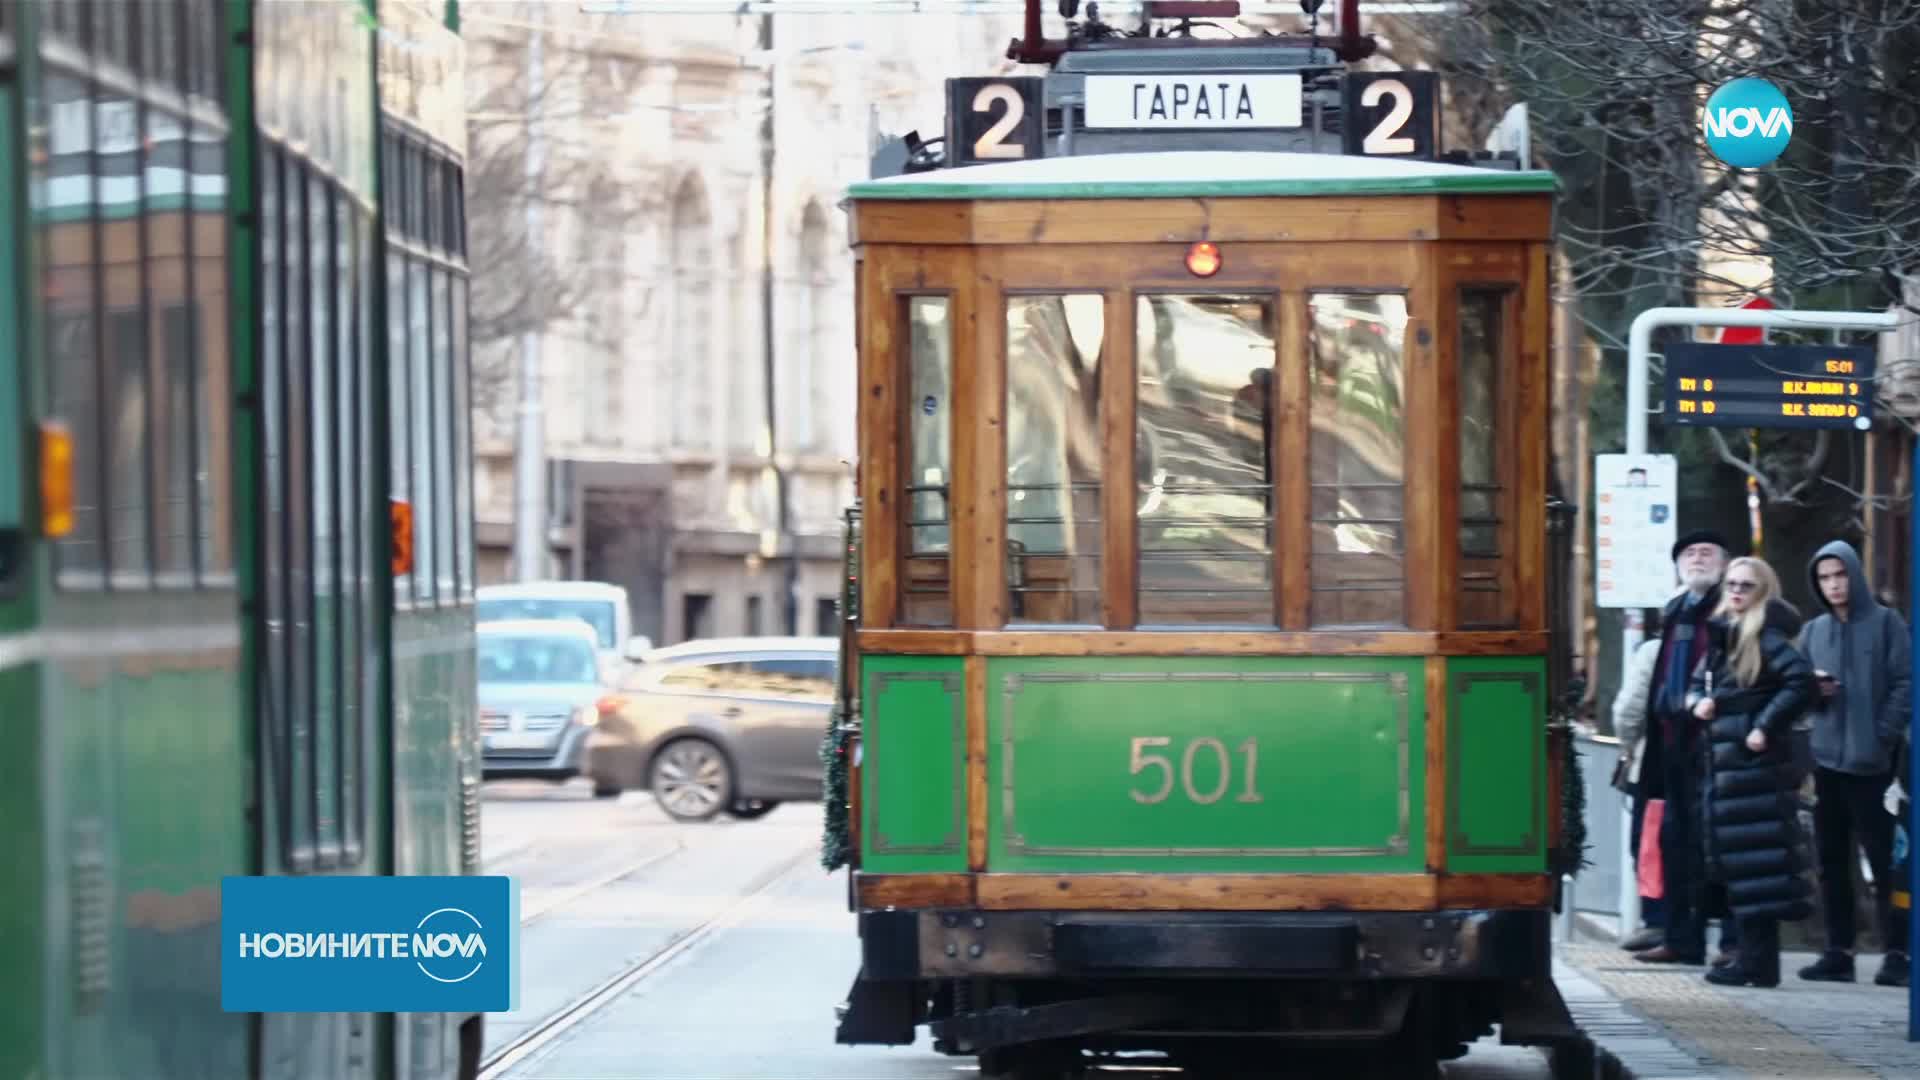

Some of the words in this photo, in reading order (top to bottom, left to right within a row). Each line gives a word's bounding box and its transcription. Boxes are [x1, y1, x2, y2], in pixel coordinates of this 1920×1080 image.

[972, 83, 1026, 159] 2
[1133, 83, 1254, 120] ГАРАТА
[1361, 78, 1416, 154] 2
[1129, 735, 1264, 805] 501
